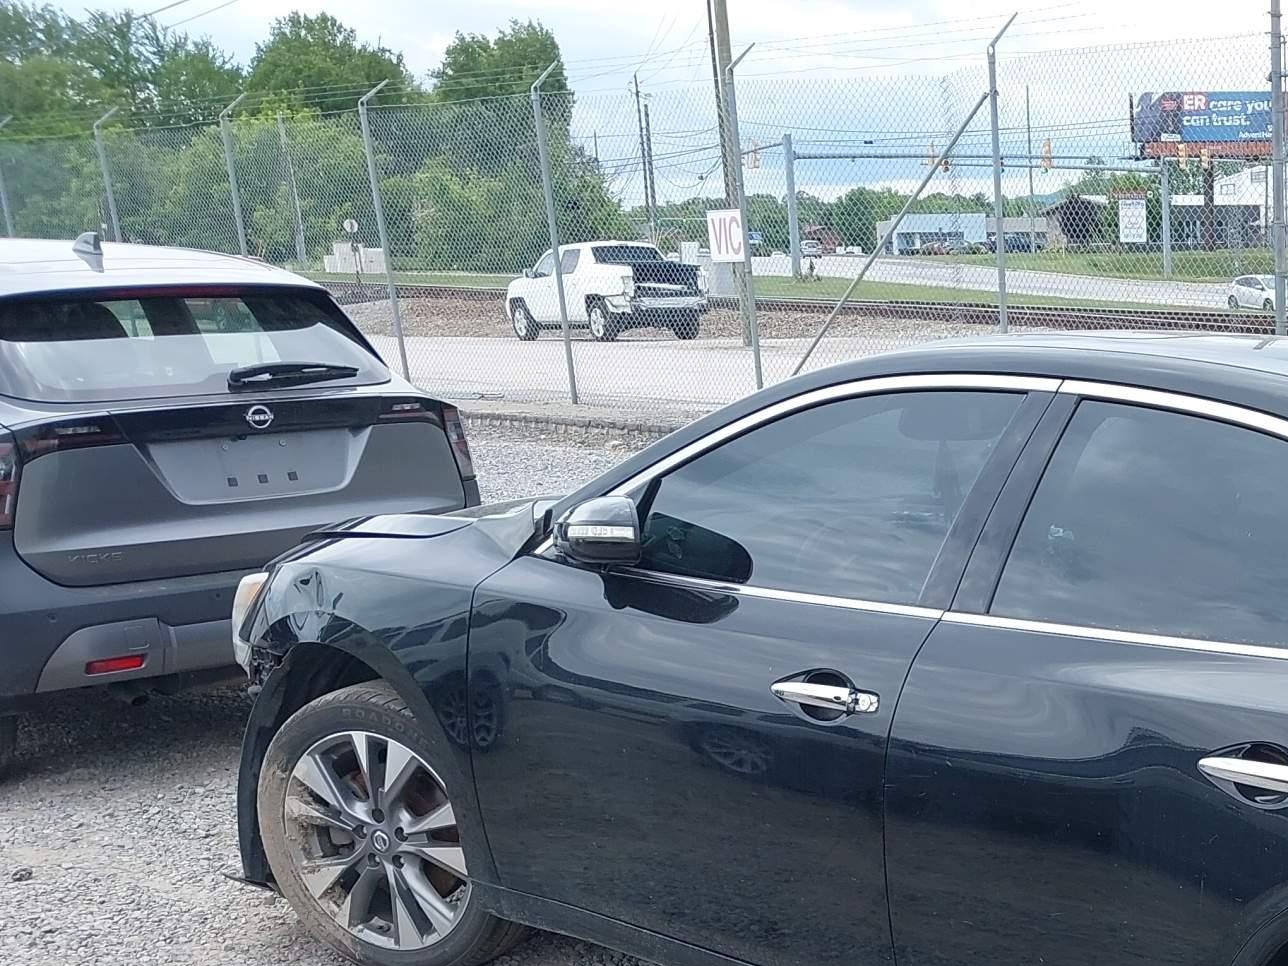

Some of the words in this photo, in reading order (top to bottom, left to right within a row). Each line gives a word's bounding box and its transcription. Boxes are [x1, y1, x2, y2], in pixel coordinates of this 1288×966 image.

[1183, 94, 1206, 110] ER
[1209, 100, 1242, 111] care
[1183, 115, 1210, 126] can
[1212, 113, 1250, 126] trust.
[711, 216, 742, 255] VIC
